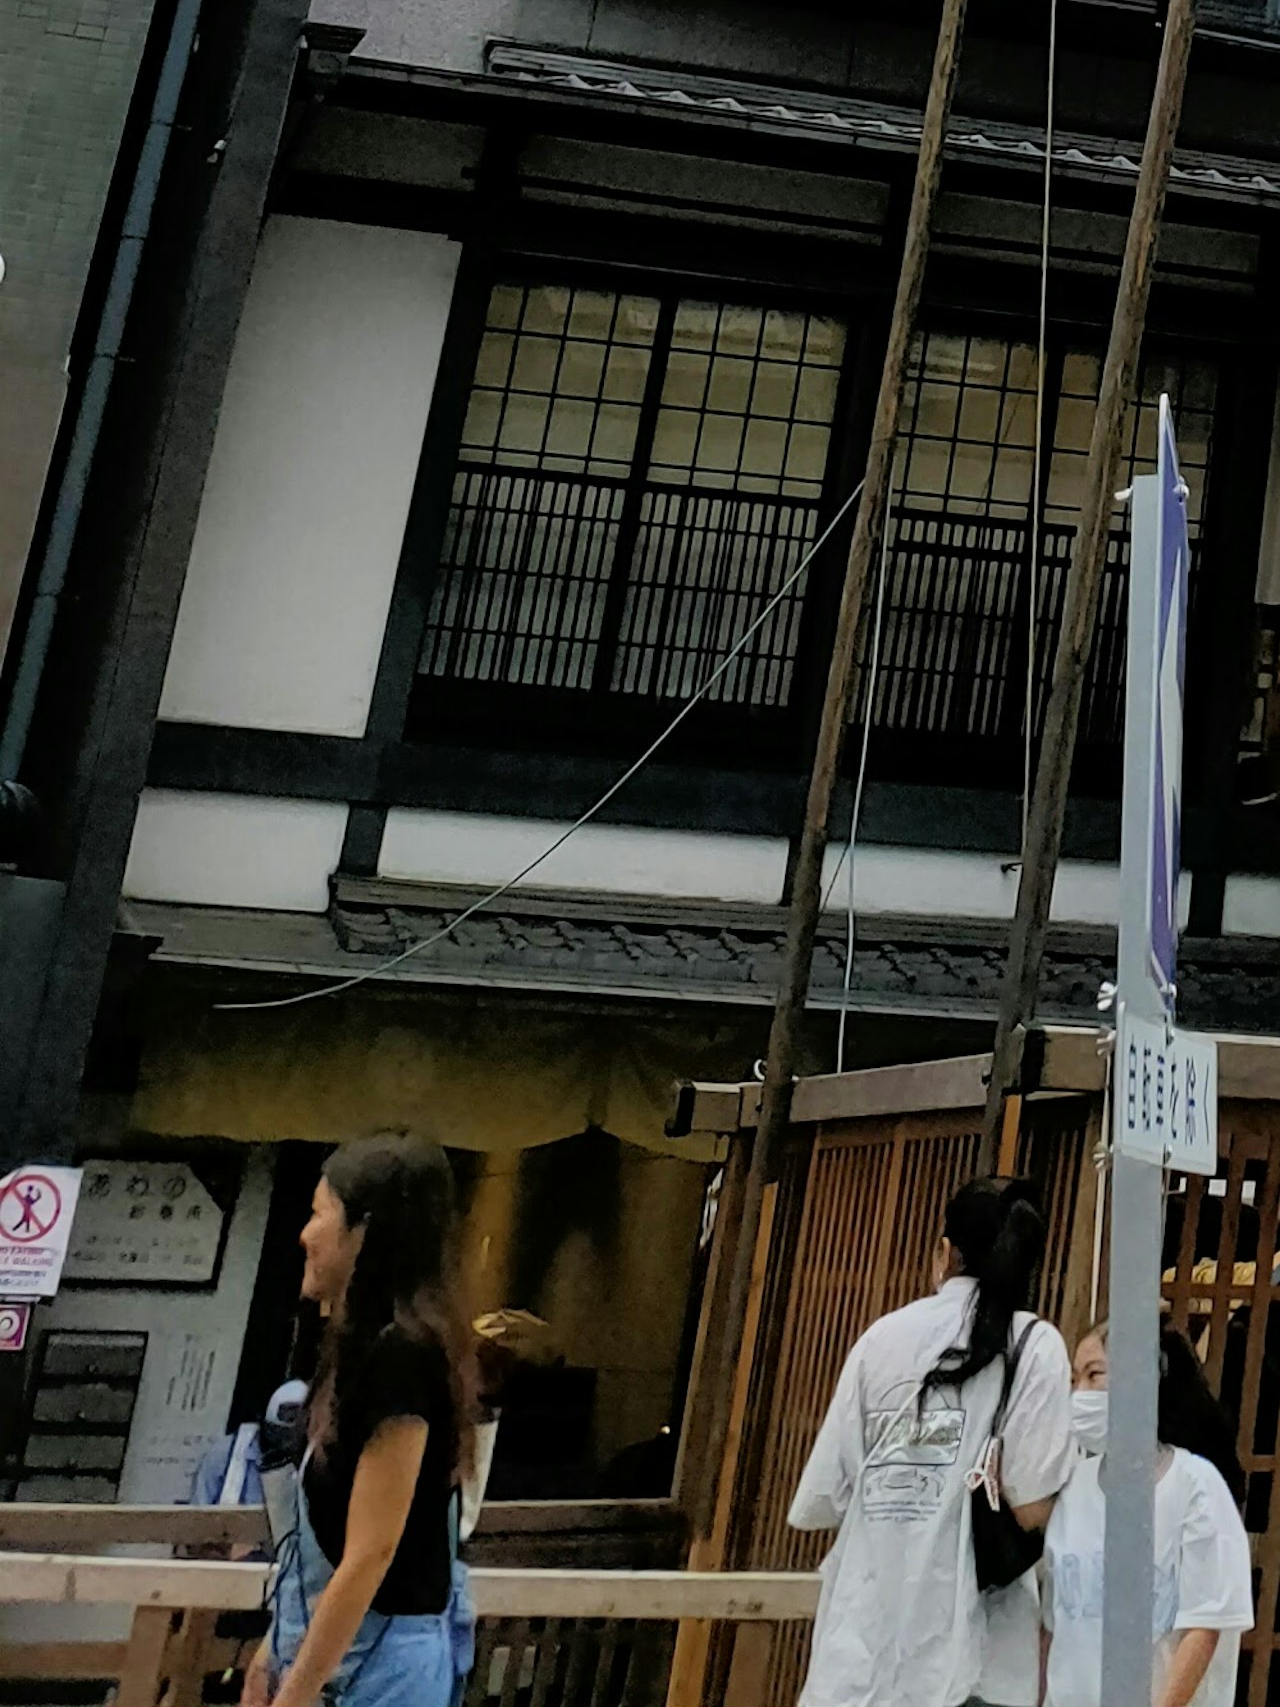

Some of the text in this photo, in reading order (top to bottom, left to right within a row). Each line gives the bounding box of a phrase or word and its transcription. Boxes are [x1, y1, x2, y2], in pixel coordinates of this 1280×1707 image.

[1128, 1033, 1210, 1145] 自転車を除く
